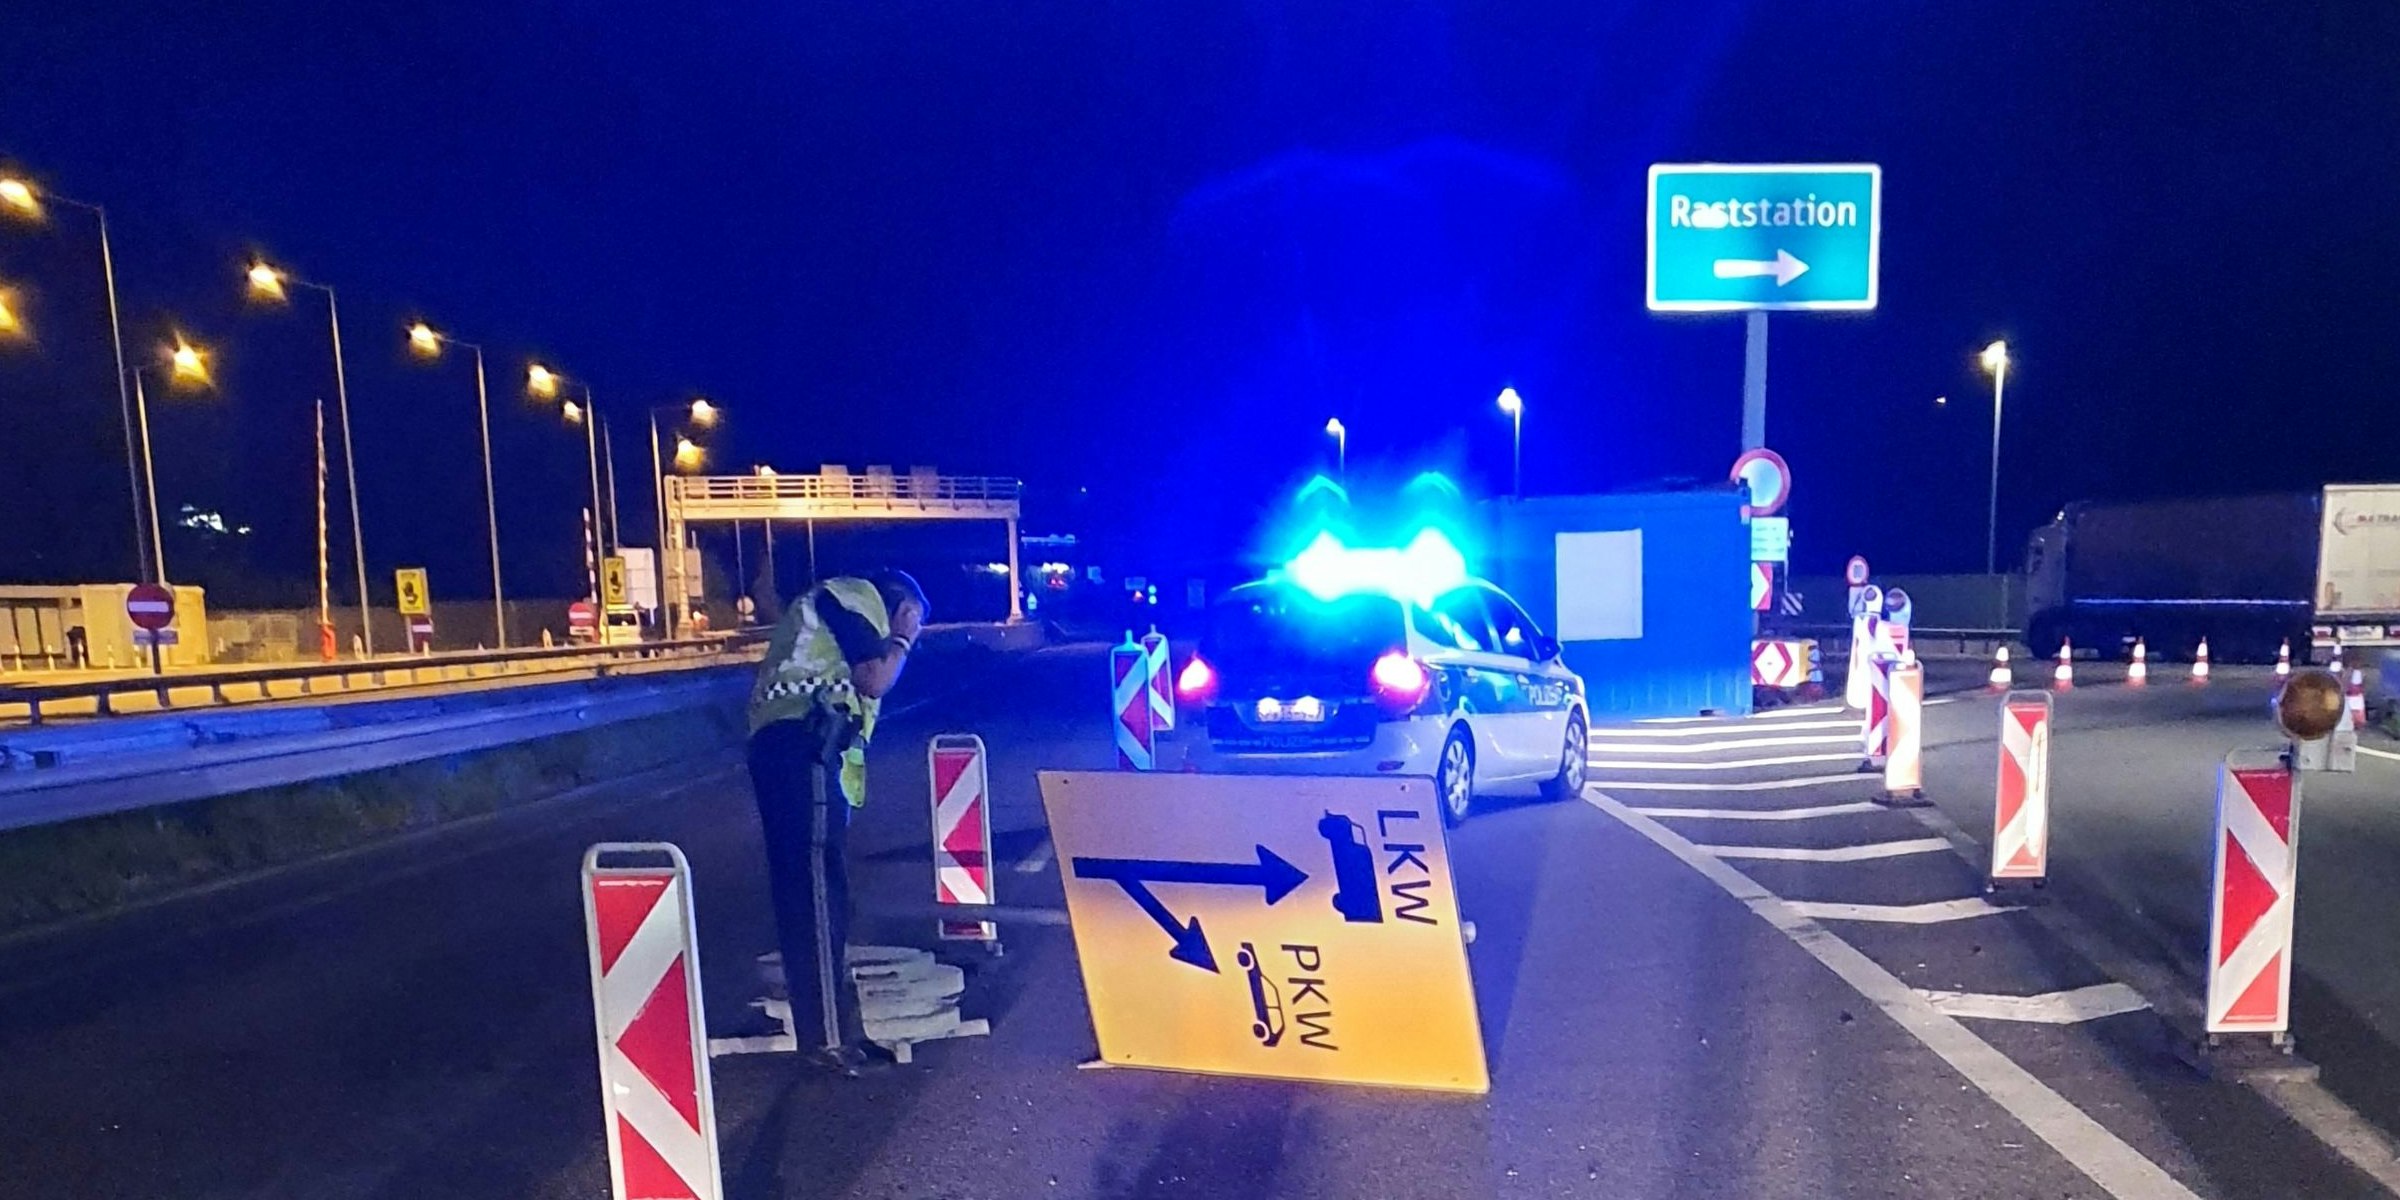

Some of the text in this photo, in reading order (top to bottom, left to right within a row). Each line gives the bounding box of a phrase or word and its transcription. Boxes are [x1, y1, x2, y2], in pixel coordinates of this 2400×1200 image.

[1671, 194, 1856, 228] Raststation
[1378, 810, 1438, 925] LKW
[1281, 944, 1339, 1051] PKW
